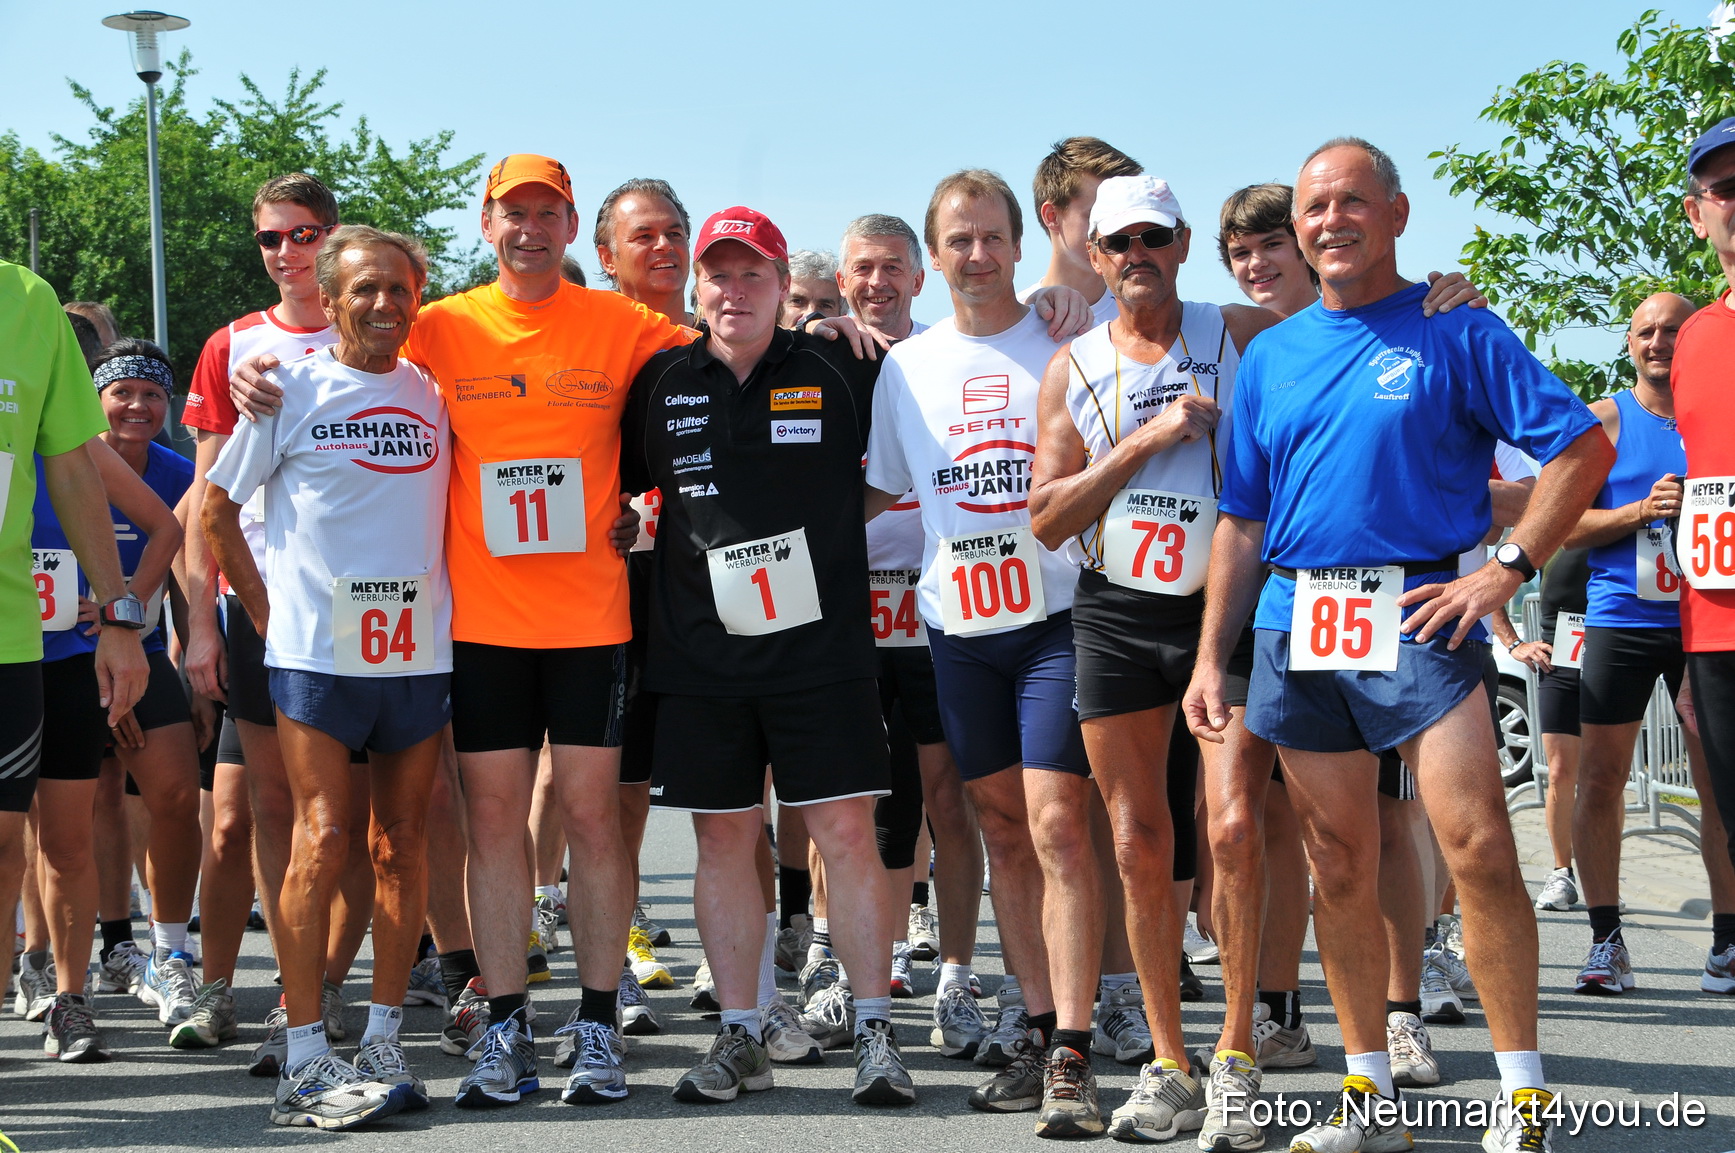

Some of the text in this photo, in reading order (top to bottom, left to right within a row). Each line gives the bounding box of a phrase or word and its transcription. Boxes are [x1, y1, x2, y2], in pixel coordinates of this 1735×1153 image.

[1192, 362, 1219, 376] asics
[456, 384, 475, 393] PETER
[1137, 383, 1189, 399] INTERSPORT
[456, 391, 512, 402] KRONENBERG
[665, 394, 709, 407] Cellagon
[676, 416, 709, 430] killtec
[948, 417, 1026, 437] SEAT
[311, 422, 432, 440] GERHART &
[788, 426, 817, 437] victory
[315, 442, 369, 452] Autohaus
[672, 452, 712, 467] AMADEUS
[497, 465, 544, 480] MEYER
[497, 476, 545, 487] WERBUNG
[1691, 482, 1725, 497] MEYER
[1127, 493, 1178, 510] MEYER
[1691, 496, 1725, 507] WERBUNG
[510, 488, 549, 543] 11
[1126, 505, 1178, 519] WERBUNG
[952, 536, 996, 553] MEYER
[1131, 520, 1186, 583] 73
[1691, 511, 1735, 578] 58
[725, 543, 771, 563] MEYER
[952, 548, 997, 562] WERBUNG
[725, 554, 773, 571] WERBUNG
[1310, 568, 1358, 581] MEYER
[351, 582, 400, 594] MEYER
[951, 557, 1031, 621] 100
[1309, 581, 1358, 591] WERBUNG
[351, 593, 401, 602] WERBUNG
[750, 567, 777, 621] 1
[870, 590, 920, 640] 54
[1310, 595, 1373, 659] 85
[361, 607, 417, 665] 64
[291, 1030, 309, 1040] TECH
